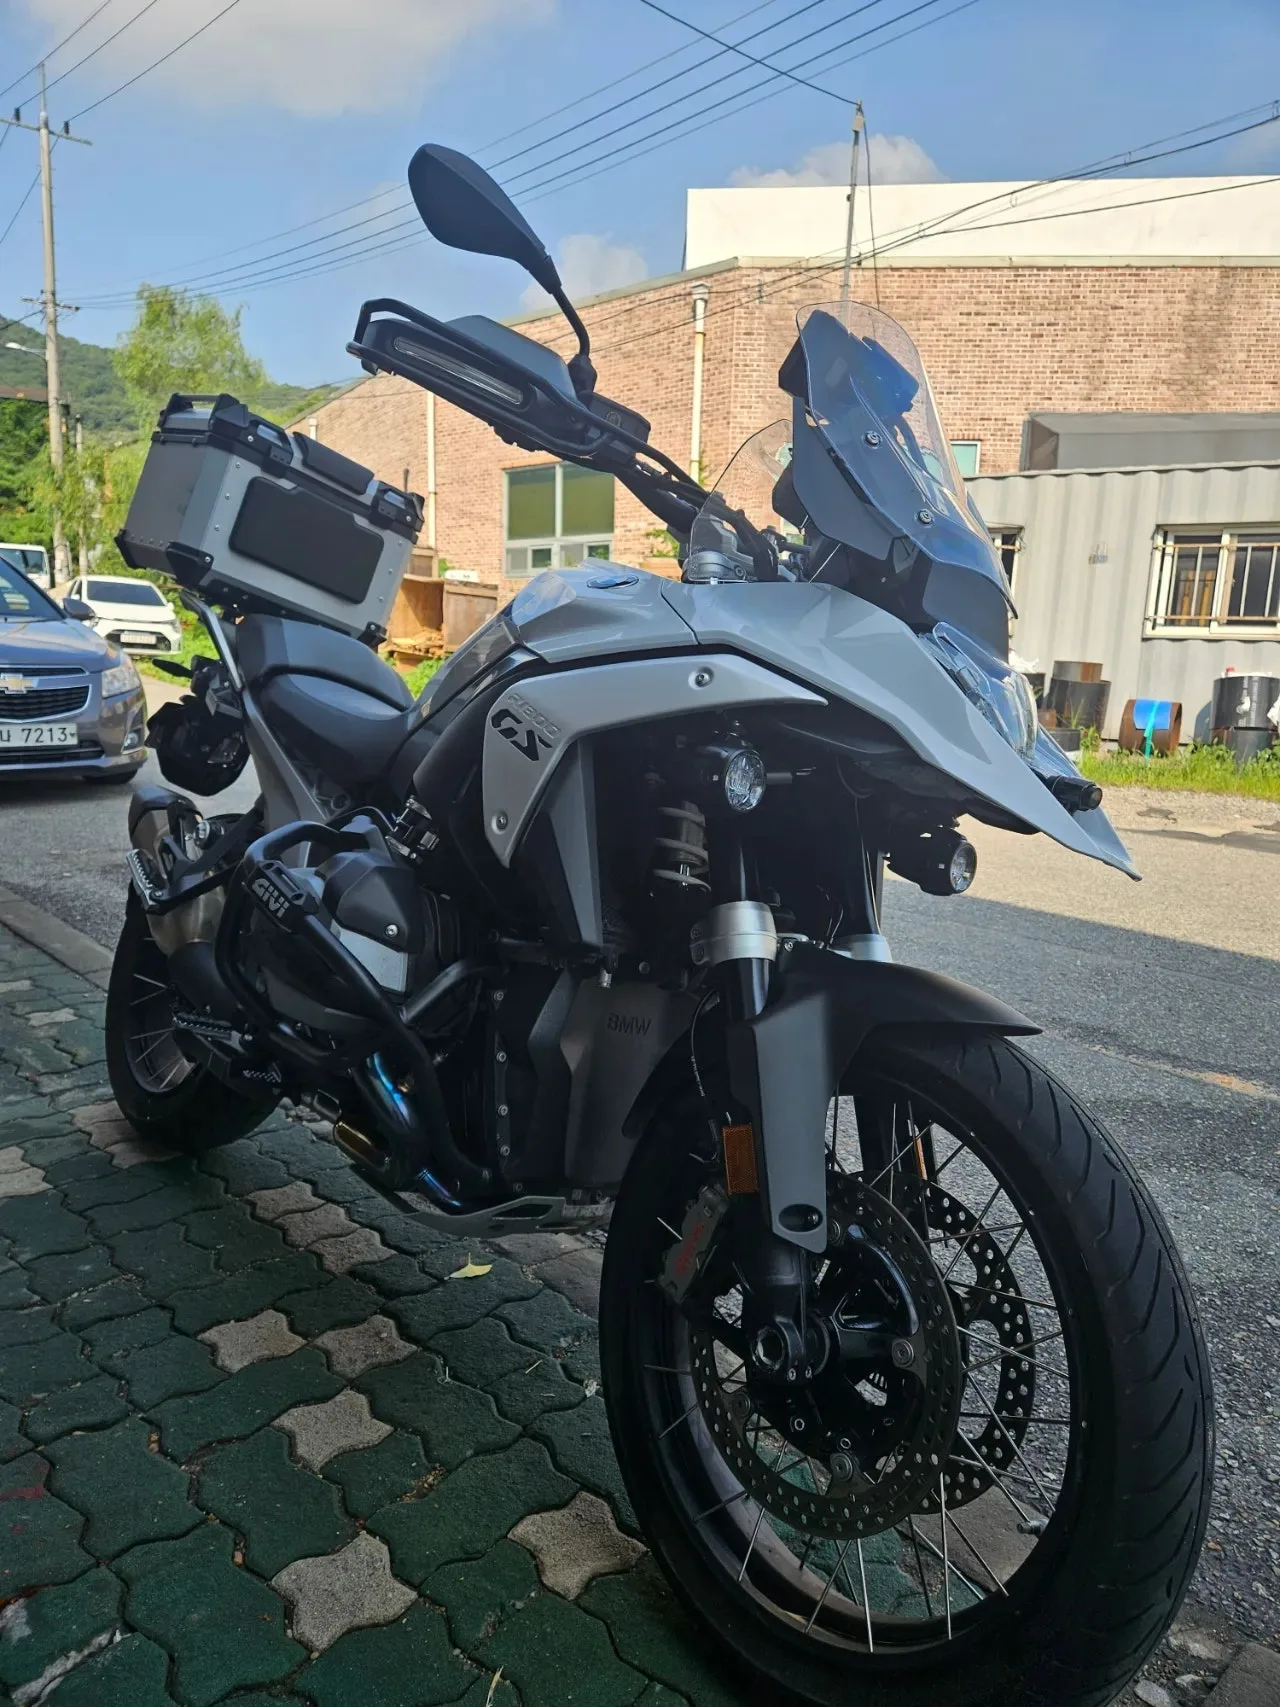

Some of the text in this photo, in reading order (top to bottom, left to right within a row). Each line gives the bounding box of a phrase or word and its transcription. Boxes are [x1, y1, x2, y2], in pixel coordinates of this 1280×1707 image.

[21, 727, 68, 743] 7213
[490, 708, 553, 762] GS
[251, 878, 290, 918] GIVI
[607, 1012, 652, 1036] BMW
